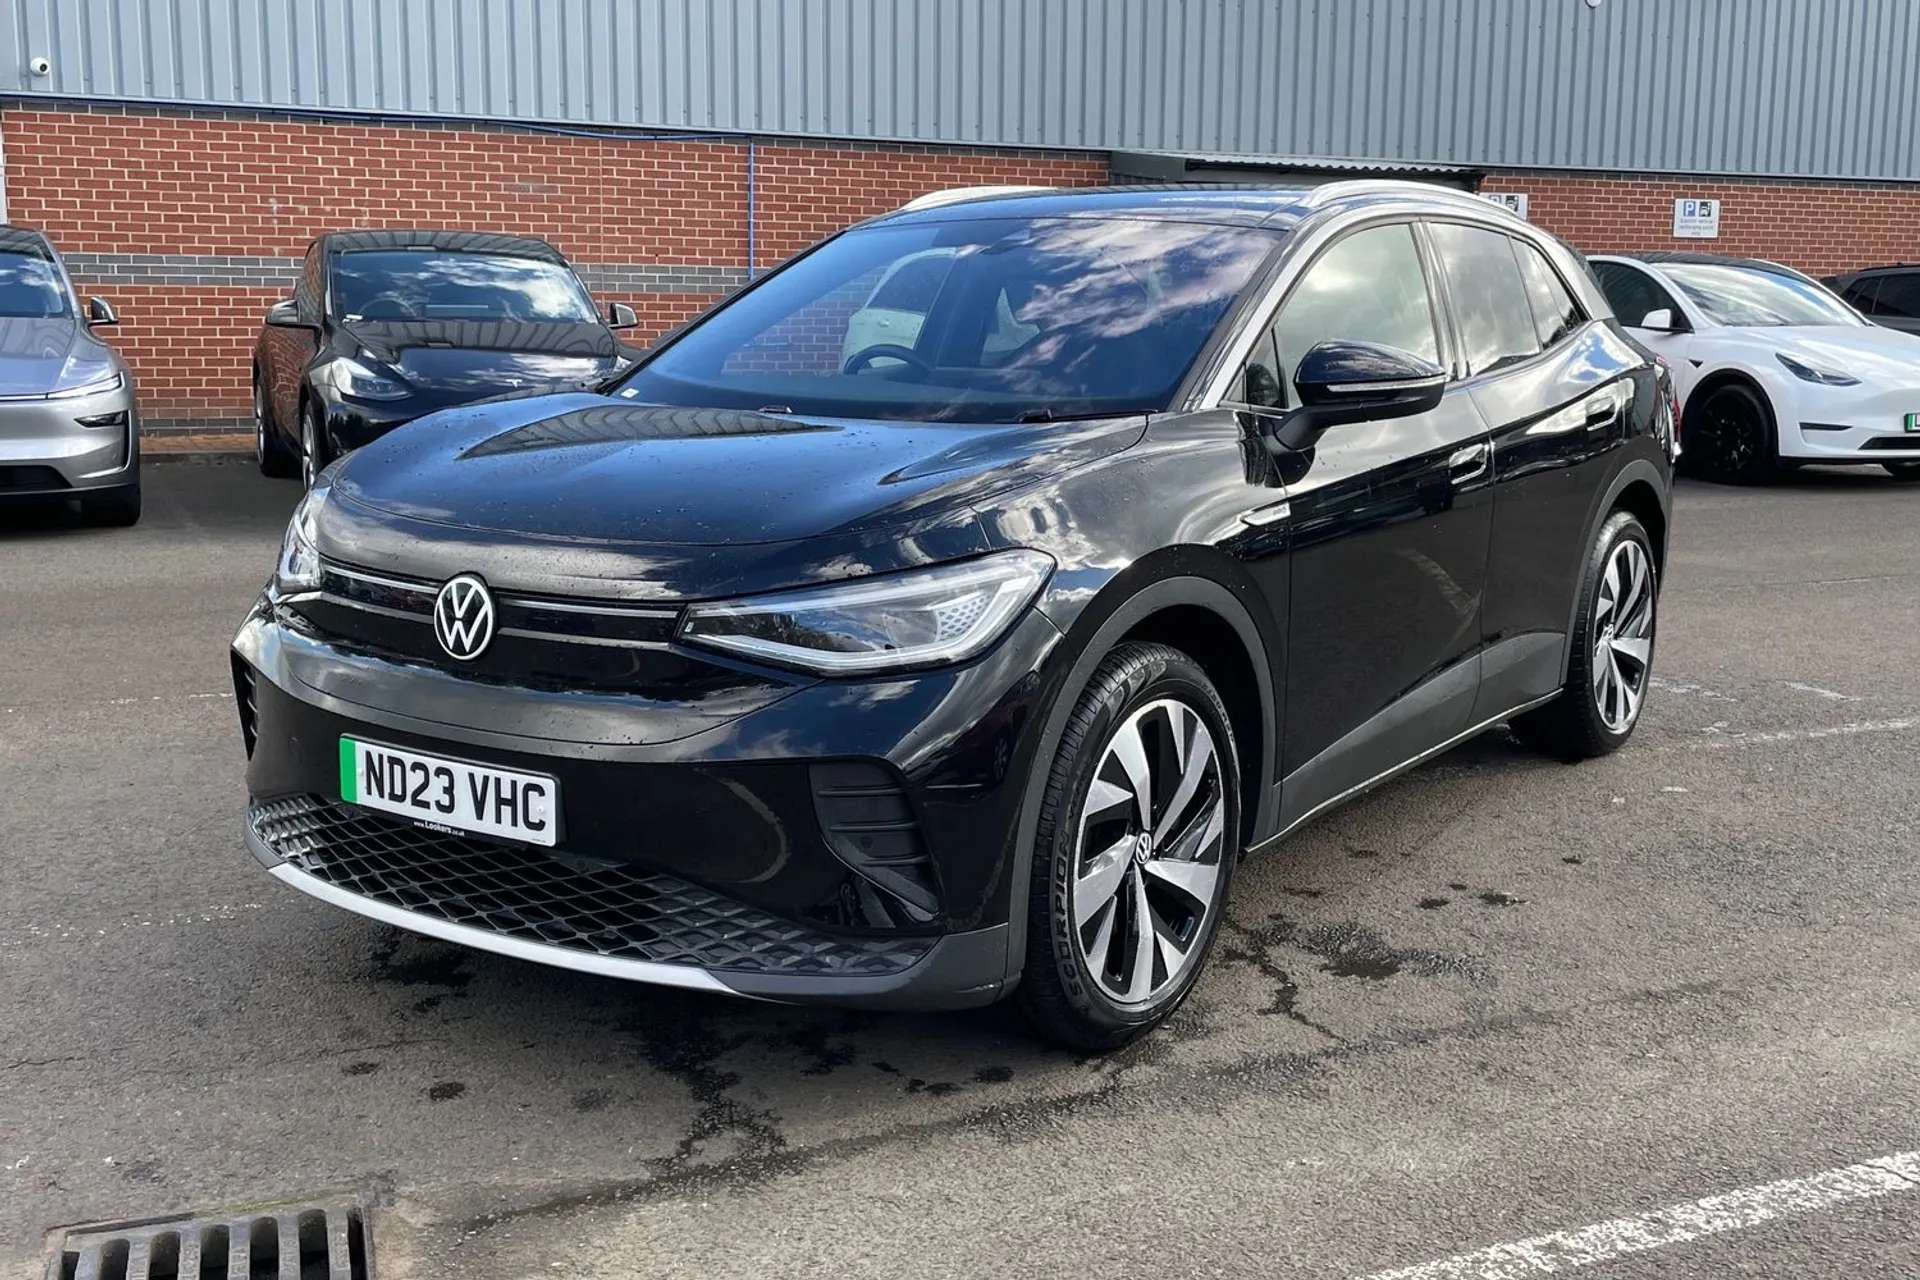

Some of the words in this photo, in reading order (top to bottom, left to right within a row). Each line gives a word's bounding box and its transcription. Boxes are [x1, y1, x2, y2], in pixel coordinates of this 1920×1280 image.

[1685, 202, 1695, 216] P
[436, 579, 491, 656] VW
[365, 750, 455, 814] ND23
[468, 772, 546, 832] VHC
[1055, 829, 1084, 997] SCORPION
